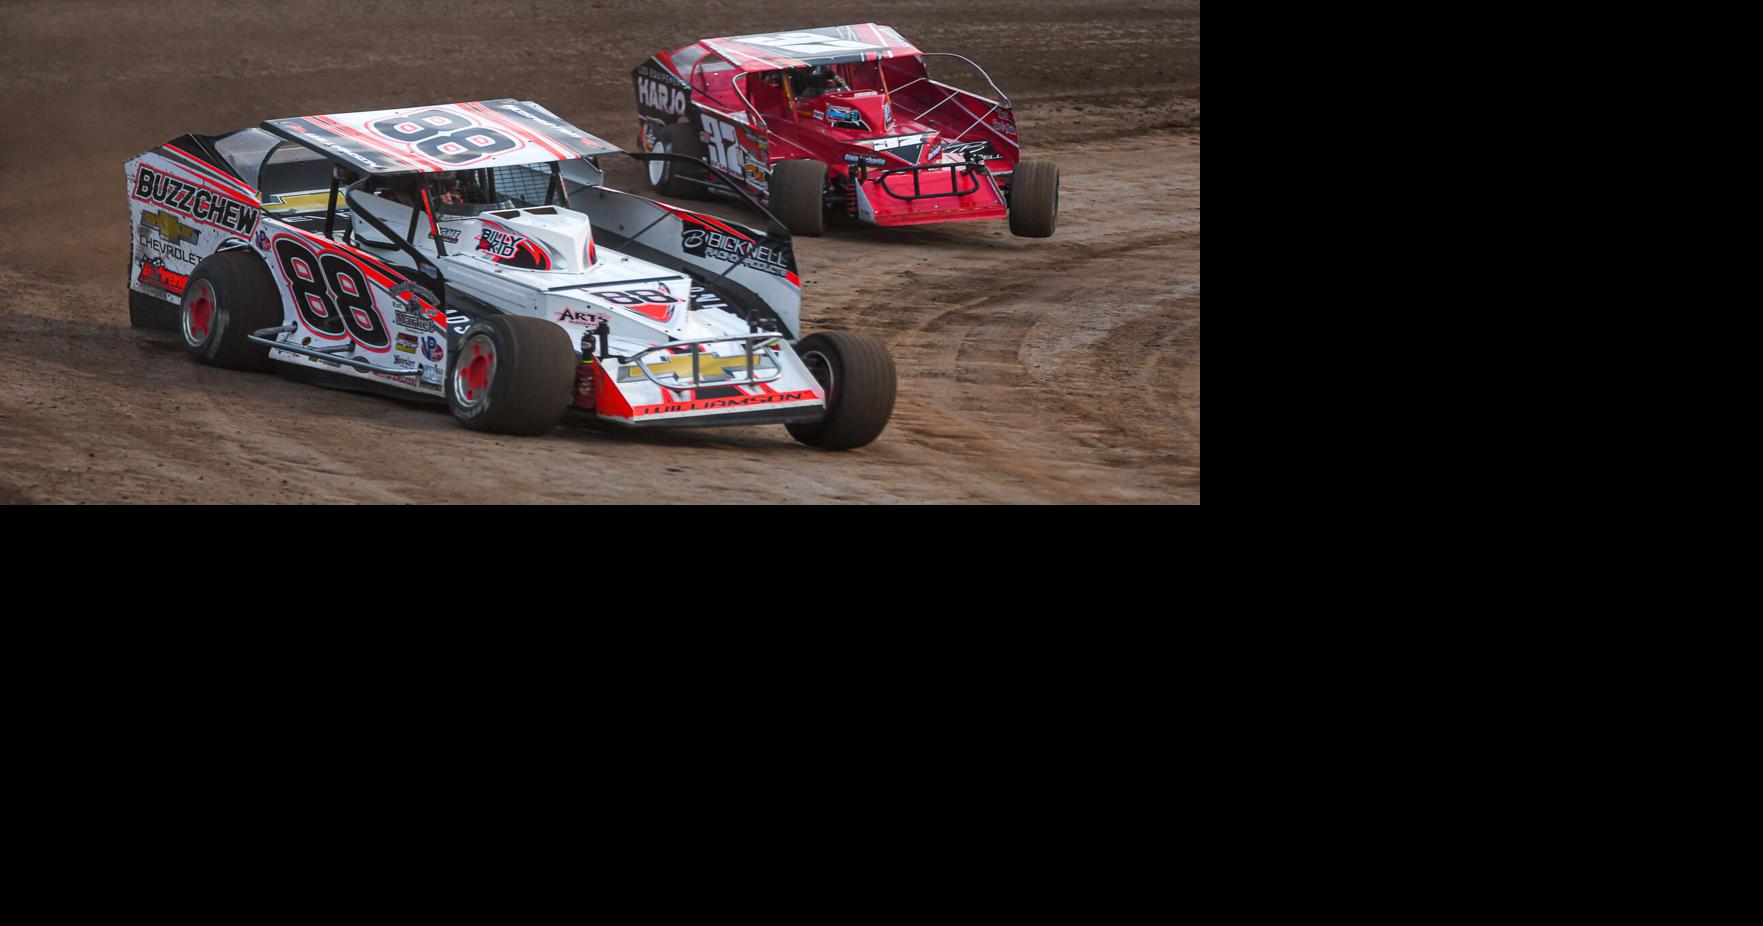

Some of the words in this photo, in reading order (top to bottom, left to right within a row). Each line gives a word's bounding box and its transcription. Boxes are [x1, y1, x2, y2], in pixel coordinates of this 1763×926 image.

[638, 77, 686, 115] HARJO
[372, 108, 517, 163] 88
[135, 167, 258, 236] BUZZCHEW
[481, 228, 523, 247] BILLY
[488, 241, 515, 257] KID
[707, 231, 788, 268] BICKNELL
[274, 238, 391, 348] 88
[589, 288, 683, 305] 88
